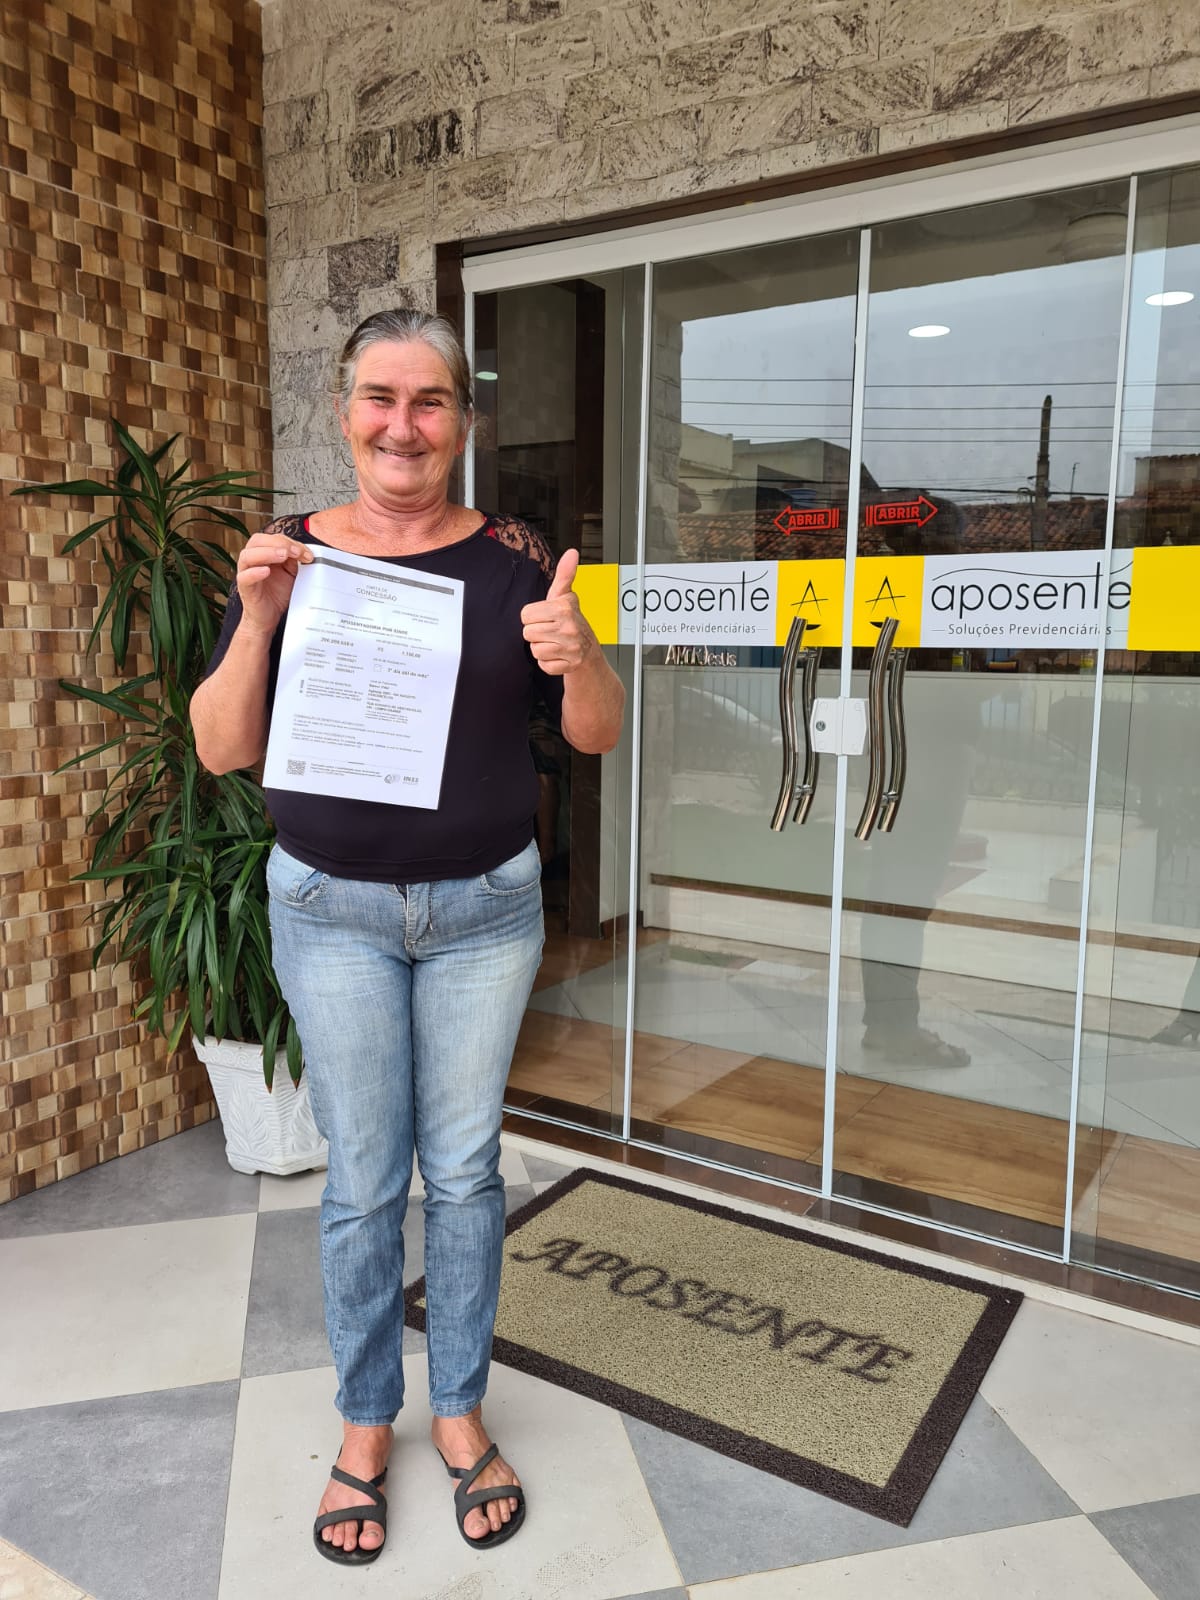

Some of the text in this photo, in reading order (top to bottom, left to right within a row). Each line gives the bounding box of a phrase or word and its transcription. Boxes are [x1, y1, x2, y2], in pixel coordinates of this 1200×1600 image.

[788, 514, 825, 526] ABRIR
[878, 506, 920, 520] ABRIR
[621, 570, 769, 619] aposente
[931, 561, 1132, 619] aposente
[641, 623, 756, 634] oluções Previdenciárias
[948, 622, 1112, 637] Soluções Previdenciáris
[511, 1237, 913, 1384] APOSENTE
